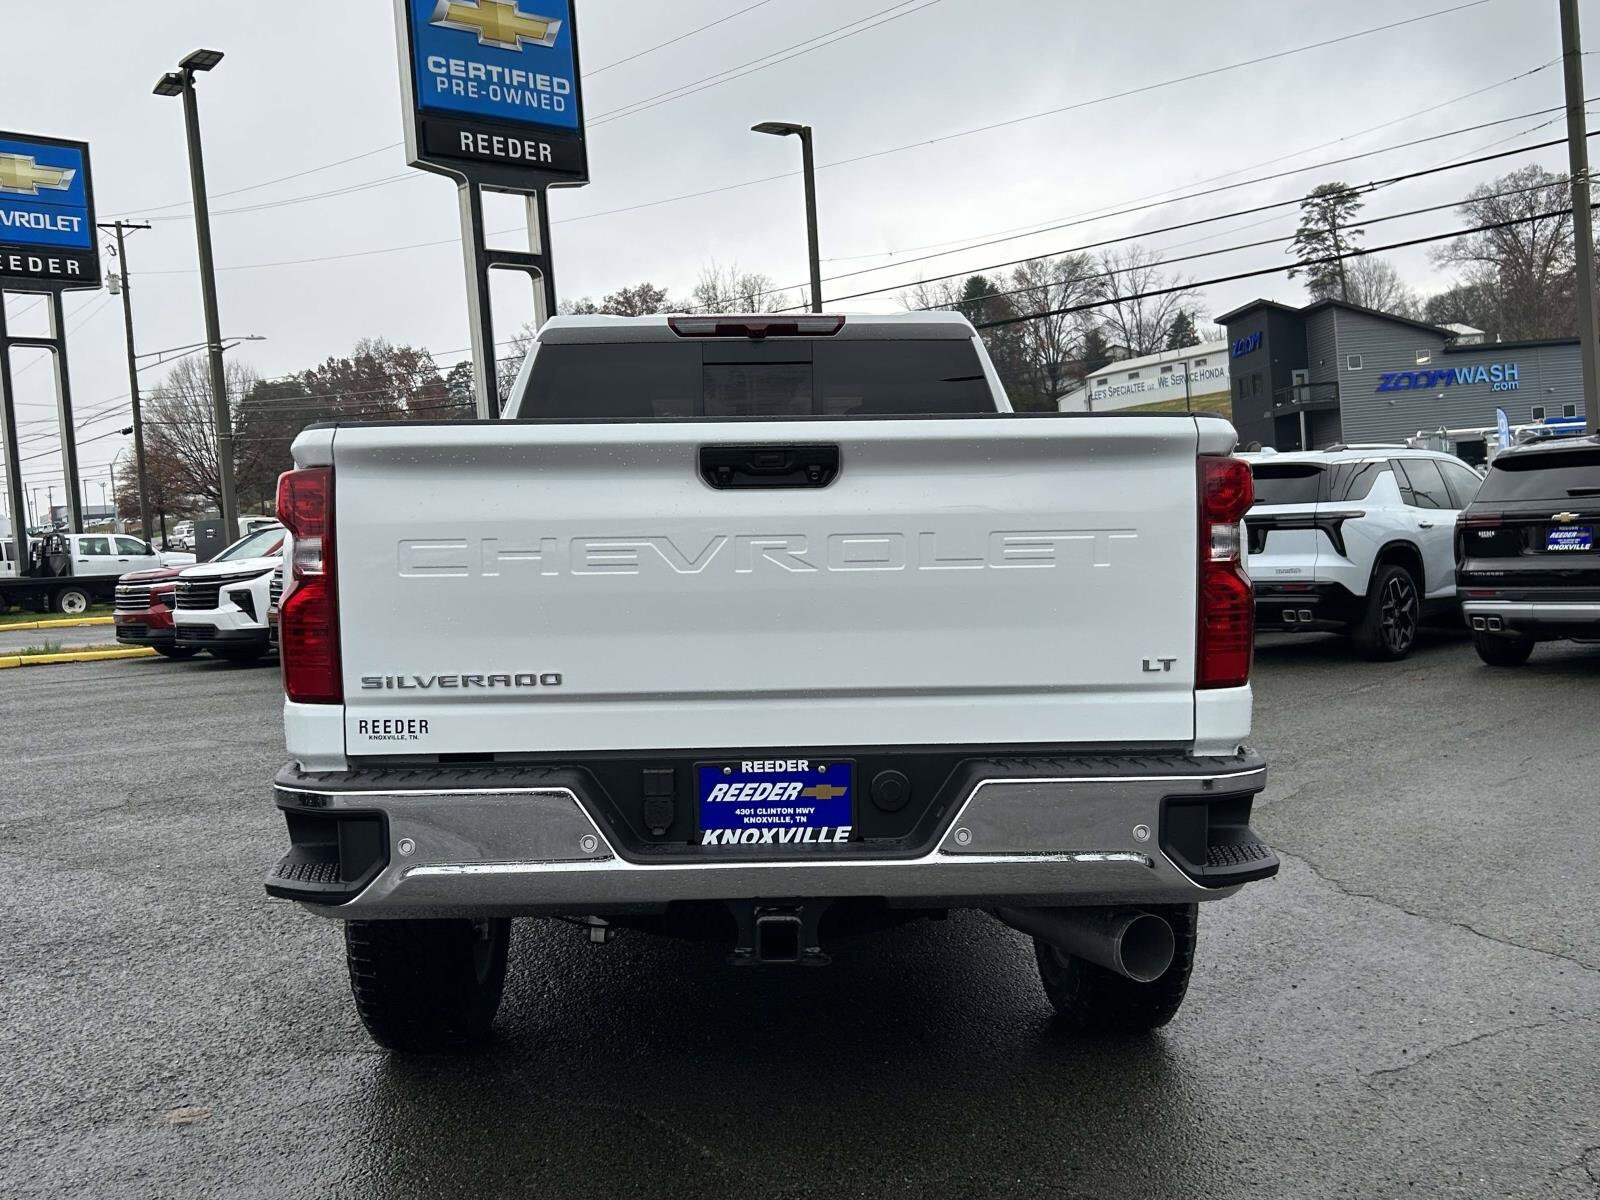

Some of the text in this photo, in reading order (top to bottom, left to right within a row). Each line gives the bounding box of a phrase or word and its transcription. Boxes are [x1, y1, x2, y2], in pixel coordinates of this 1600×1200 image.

[427, 55, 570, 95] CERTIFIED
[436, 77, 565, 112] PRE-OWNED
[460, 131, 552, 163] REEDER
[0, 210, 81, 232] VROLET
[1232, 331, 1262, 358] ZOOM
[1158, 376, 1169, 389] WE
[1170, 371, 1198, 386] SERVCE
[1200, 367, 1225, 381] HONDA
[1375, 363, 1519, 392] ZOOMWASH
[1491, 381, 1519, 391] .com
[397, 528, 1137, 577] CHEVROLET
[1142, 658, 1177, 672] LT
[361, 673, 563, 689] SILVERADO
[359, 719, 429, 734] REEDER
[741, 759, 809, 773] REEDER
[707, 782, 803, 802] REEDER
[757, 807, 794, 815] CLINTON
[795, 815, 807, 823] TN
[701, 825, 852, 845] KNOXVILLE
